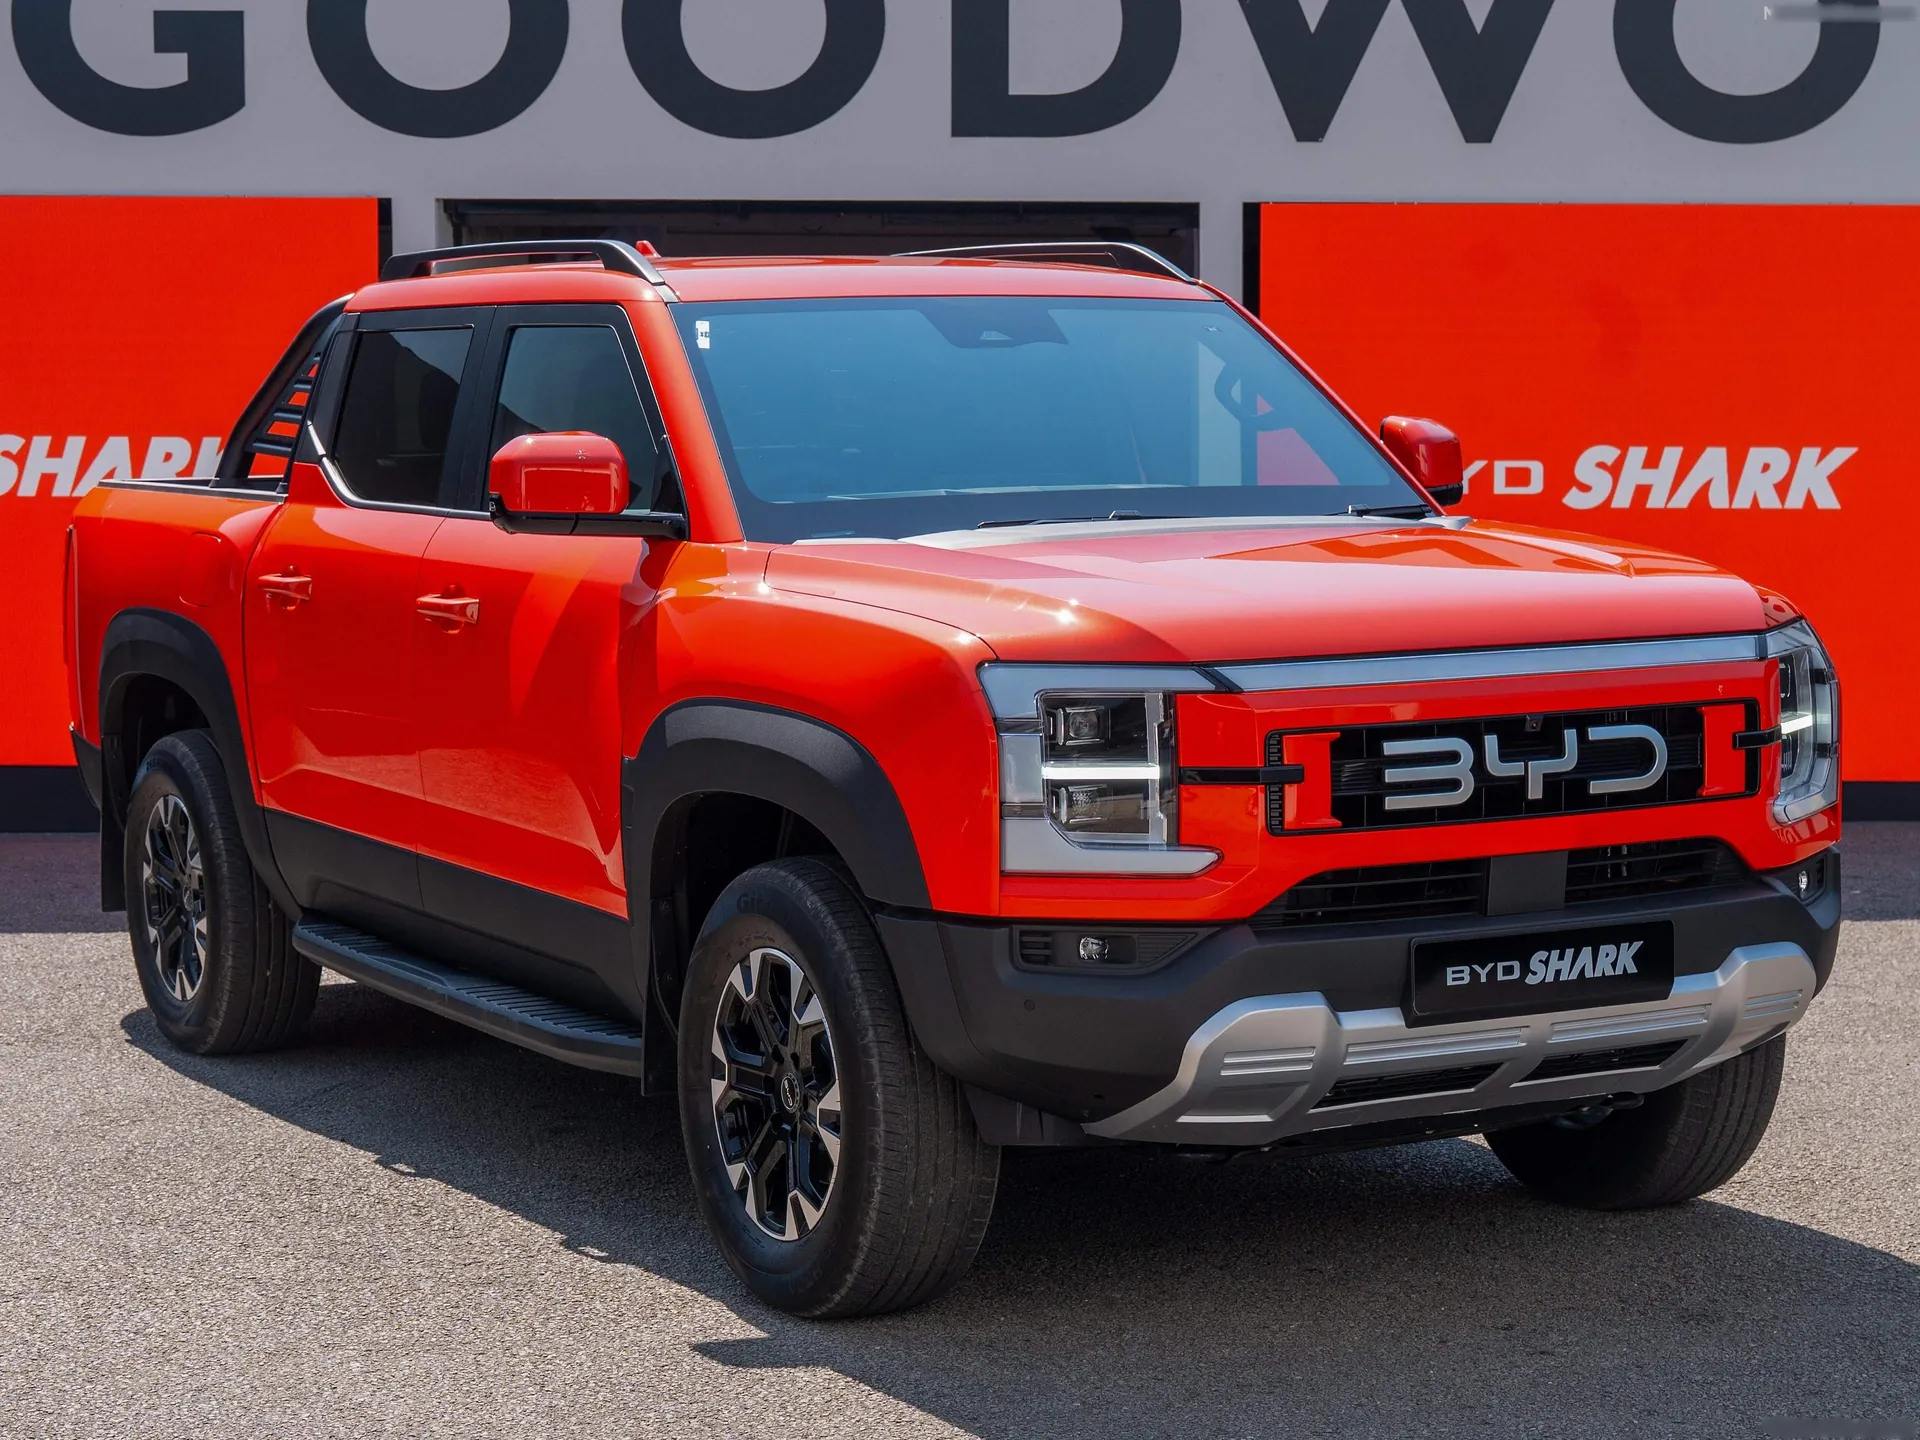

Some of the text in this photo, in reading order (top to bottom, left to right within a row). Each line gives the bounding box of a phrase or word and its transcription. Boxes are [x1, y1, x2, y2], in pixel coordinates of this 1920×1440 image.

[11, 0, 1881, 144] GOODWO
[1462, 445, 1859, 510] YD SHARK
[1383, 724, 1668, 810] BYD
[1446, 940, 1644, 986] BYD SHARK
